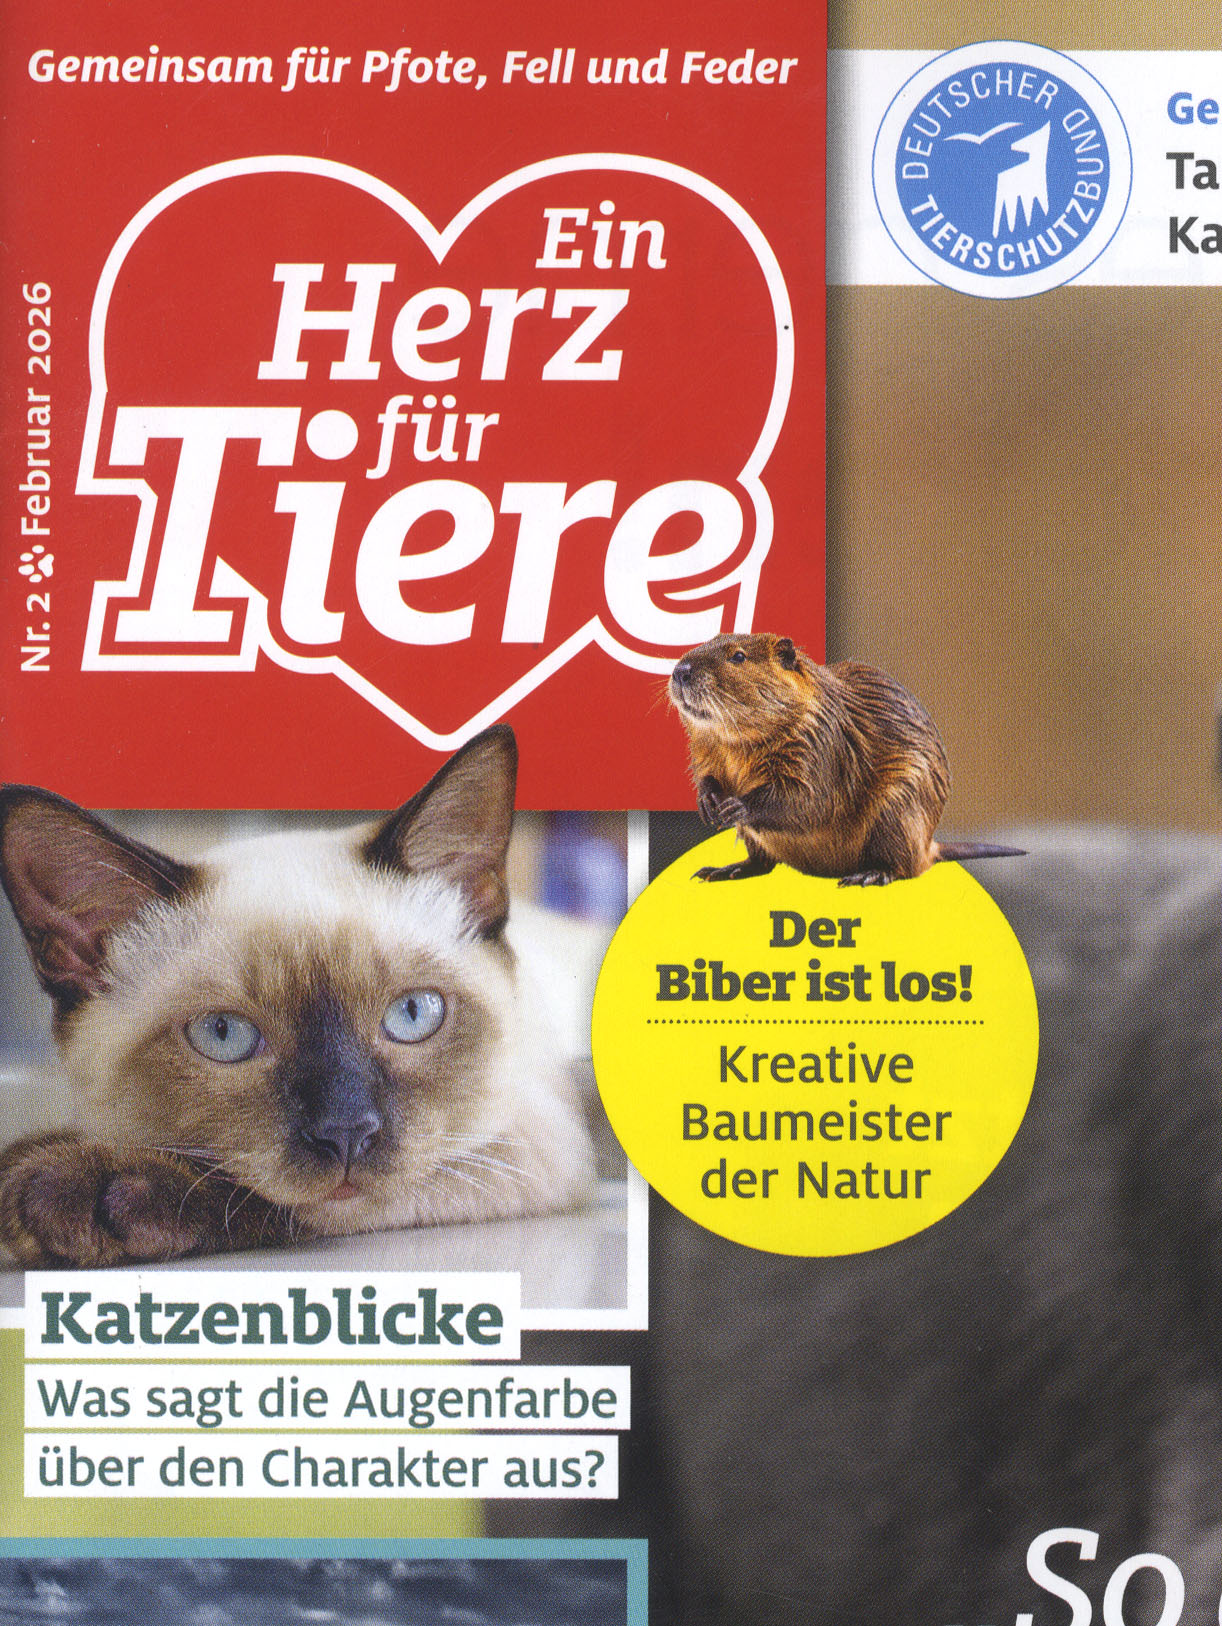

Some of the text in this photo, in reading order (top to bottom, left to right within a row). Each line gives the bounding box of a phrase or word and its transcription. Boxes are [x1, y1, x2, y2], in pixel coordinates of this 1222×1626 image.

[29, 46, 798, 92] Gemeinsam für Pfote, Fell und Feder
[902, 69, 1058, 179] DEUTSCHER
[910, 108, 1104, 271] TIERSCHUTZBUND
[536, 201, 666, 269] Ein
[258, 264, 629, 381] Herz
[366, 395, 499, 479] für
[19, 283, 51, 671] Nr. 2 Februar 2026
[108, 406, 745, 646] Tiere
[770, 911, 861, 948] Der
[656, 958, 972, 1002] Biber ist los!
[720, 1042, 913, 1083] Kreative
[683, 1100, 952, 1141] Baumeister
[701, 1158, 931, 1199] der Natur
[41, 1286, 503, 1345] Katzenblicke
[38, 1376, 617, 1429] Was sagt die Augenfarbe
[40, 1446, 604, 1488] über den Charakter aus?
